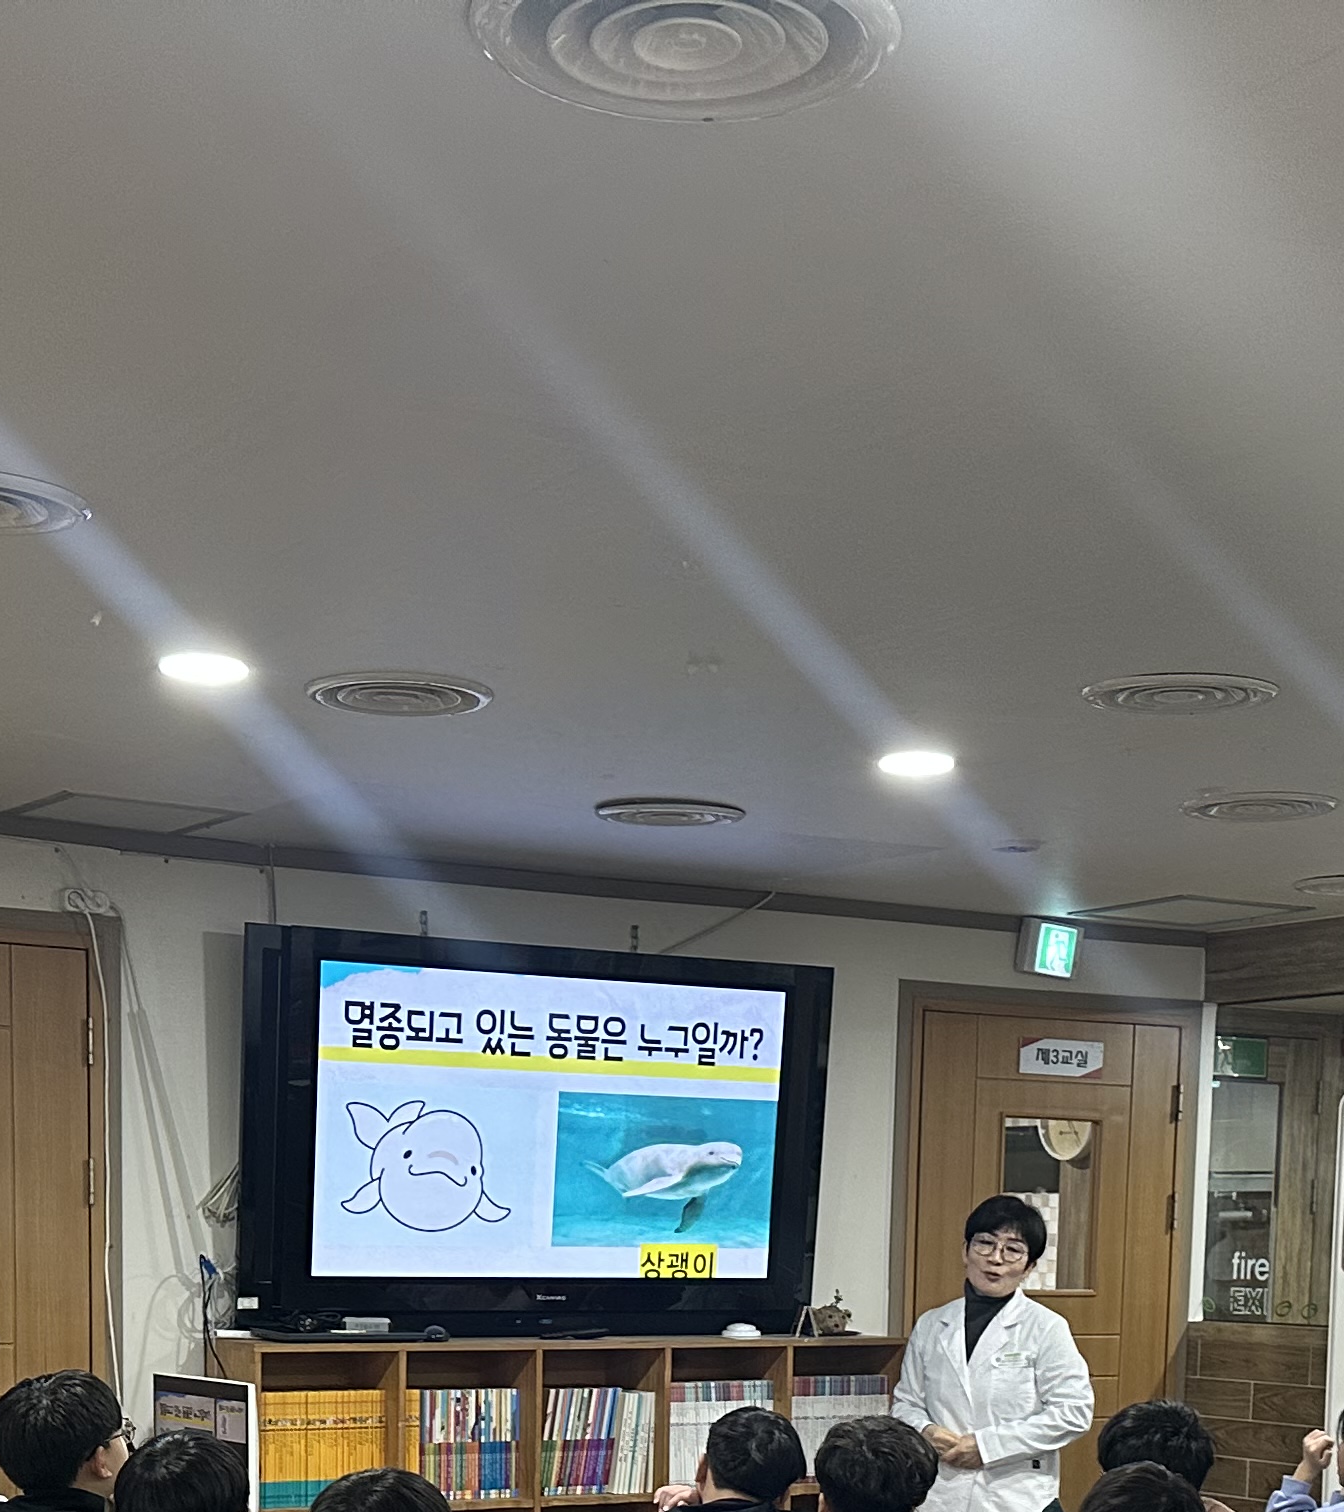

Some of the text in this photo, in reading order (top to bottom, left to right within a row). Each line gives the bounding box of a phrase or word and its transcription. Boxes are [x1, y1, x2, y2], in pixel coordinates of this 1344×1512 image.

[344, 1000, 765, 1067] 멸종되고 있는 동물은 누구일까?
[1036, 1048, 1089, 1069] 제3교실
[640, 1251, 714, 1279] 상괭이
[1232, 1251, 1270, 1281] fire
